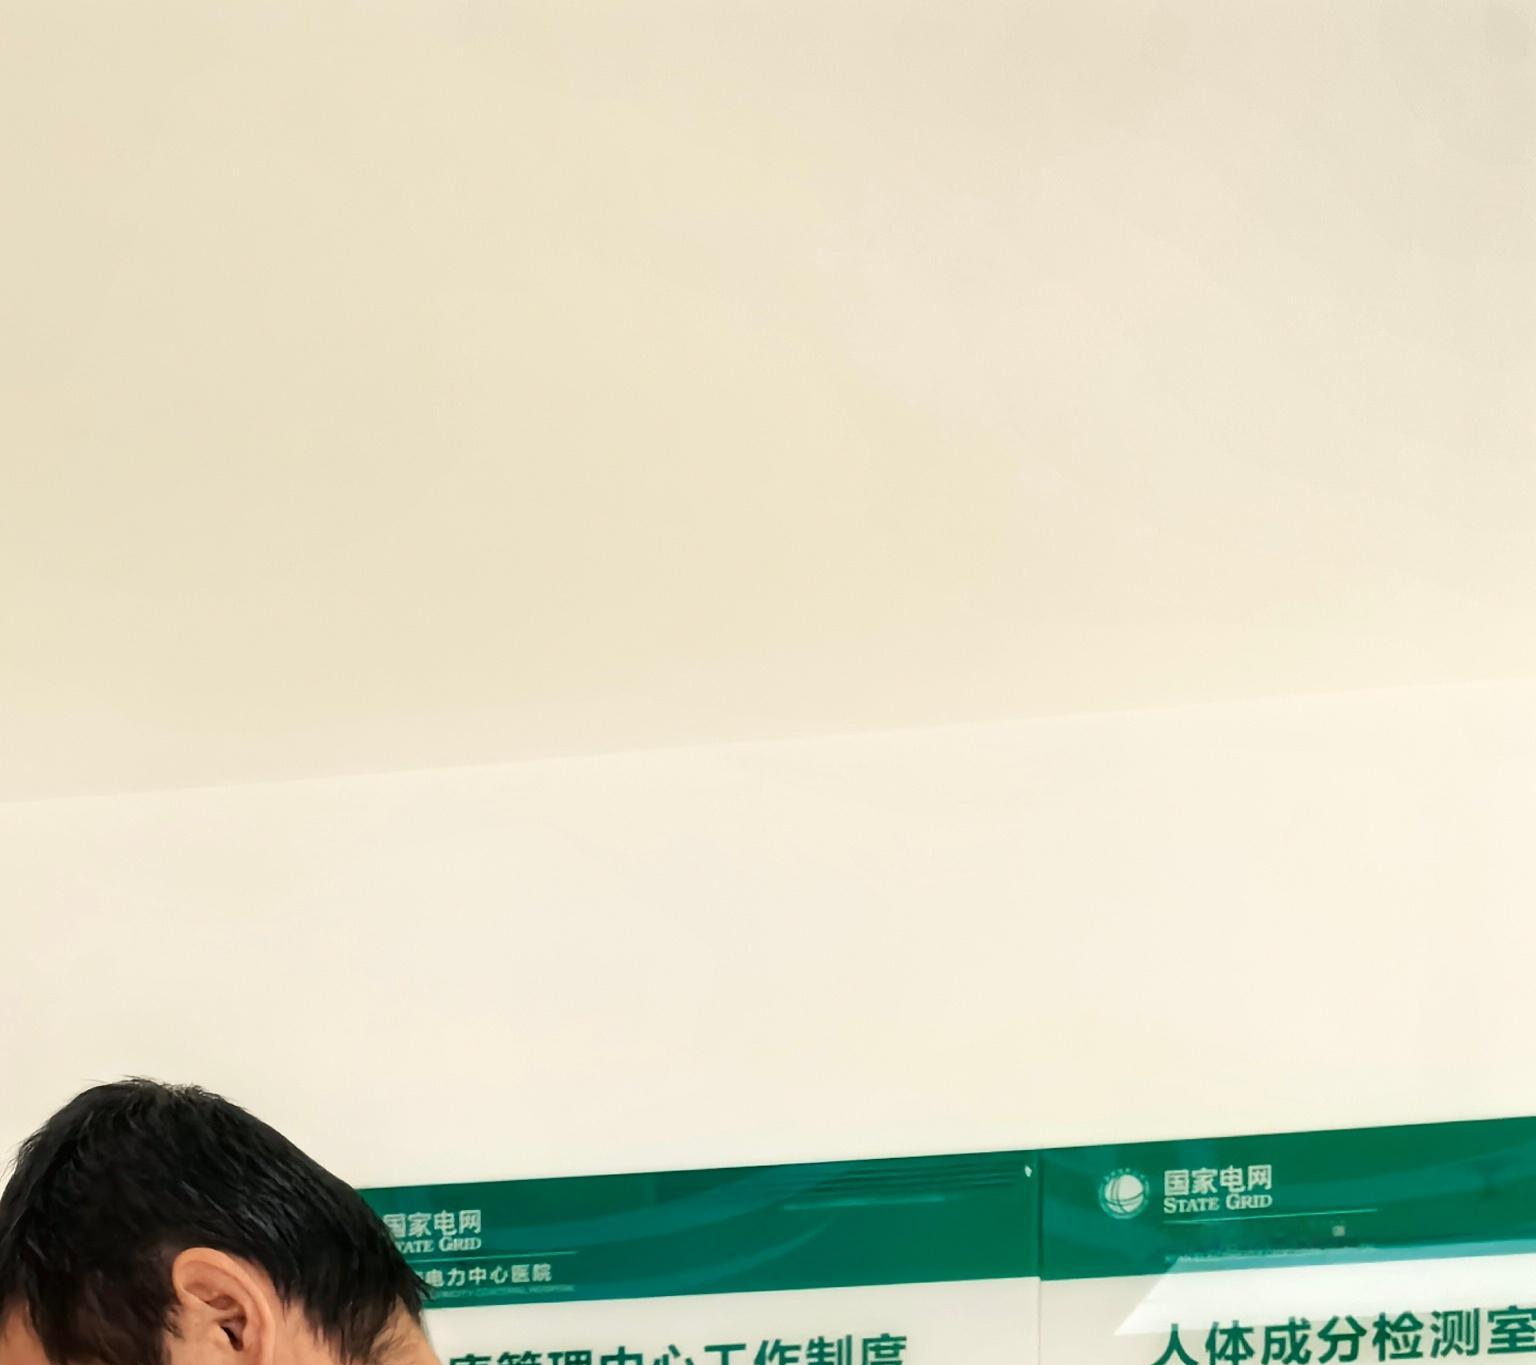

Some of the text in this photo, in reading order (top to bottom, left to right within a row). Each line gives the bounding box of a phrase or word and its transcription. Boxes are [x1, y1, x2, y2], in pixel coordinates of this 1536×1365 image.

[1164, 1164, 1272, 1196] 国家电网
[1164, 1193, 1273, 1214] STATE GRID
[383, 1209, 482, 1238] 国家电网
[394, 1239, 434, 1254] TATE
[415, 1263, 552, 1287] 电力中心医院
